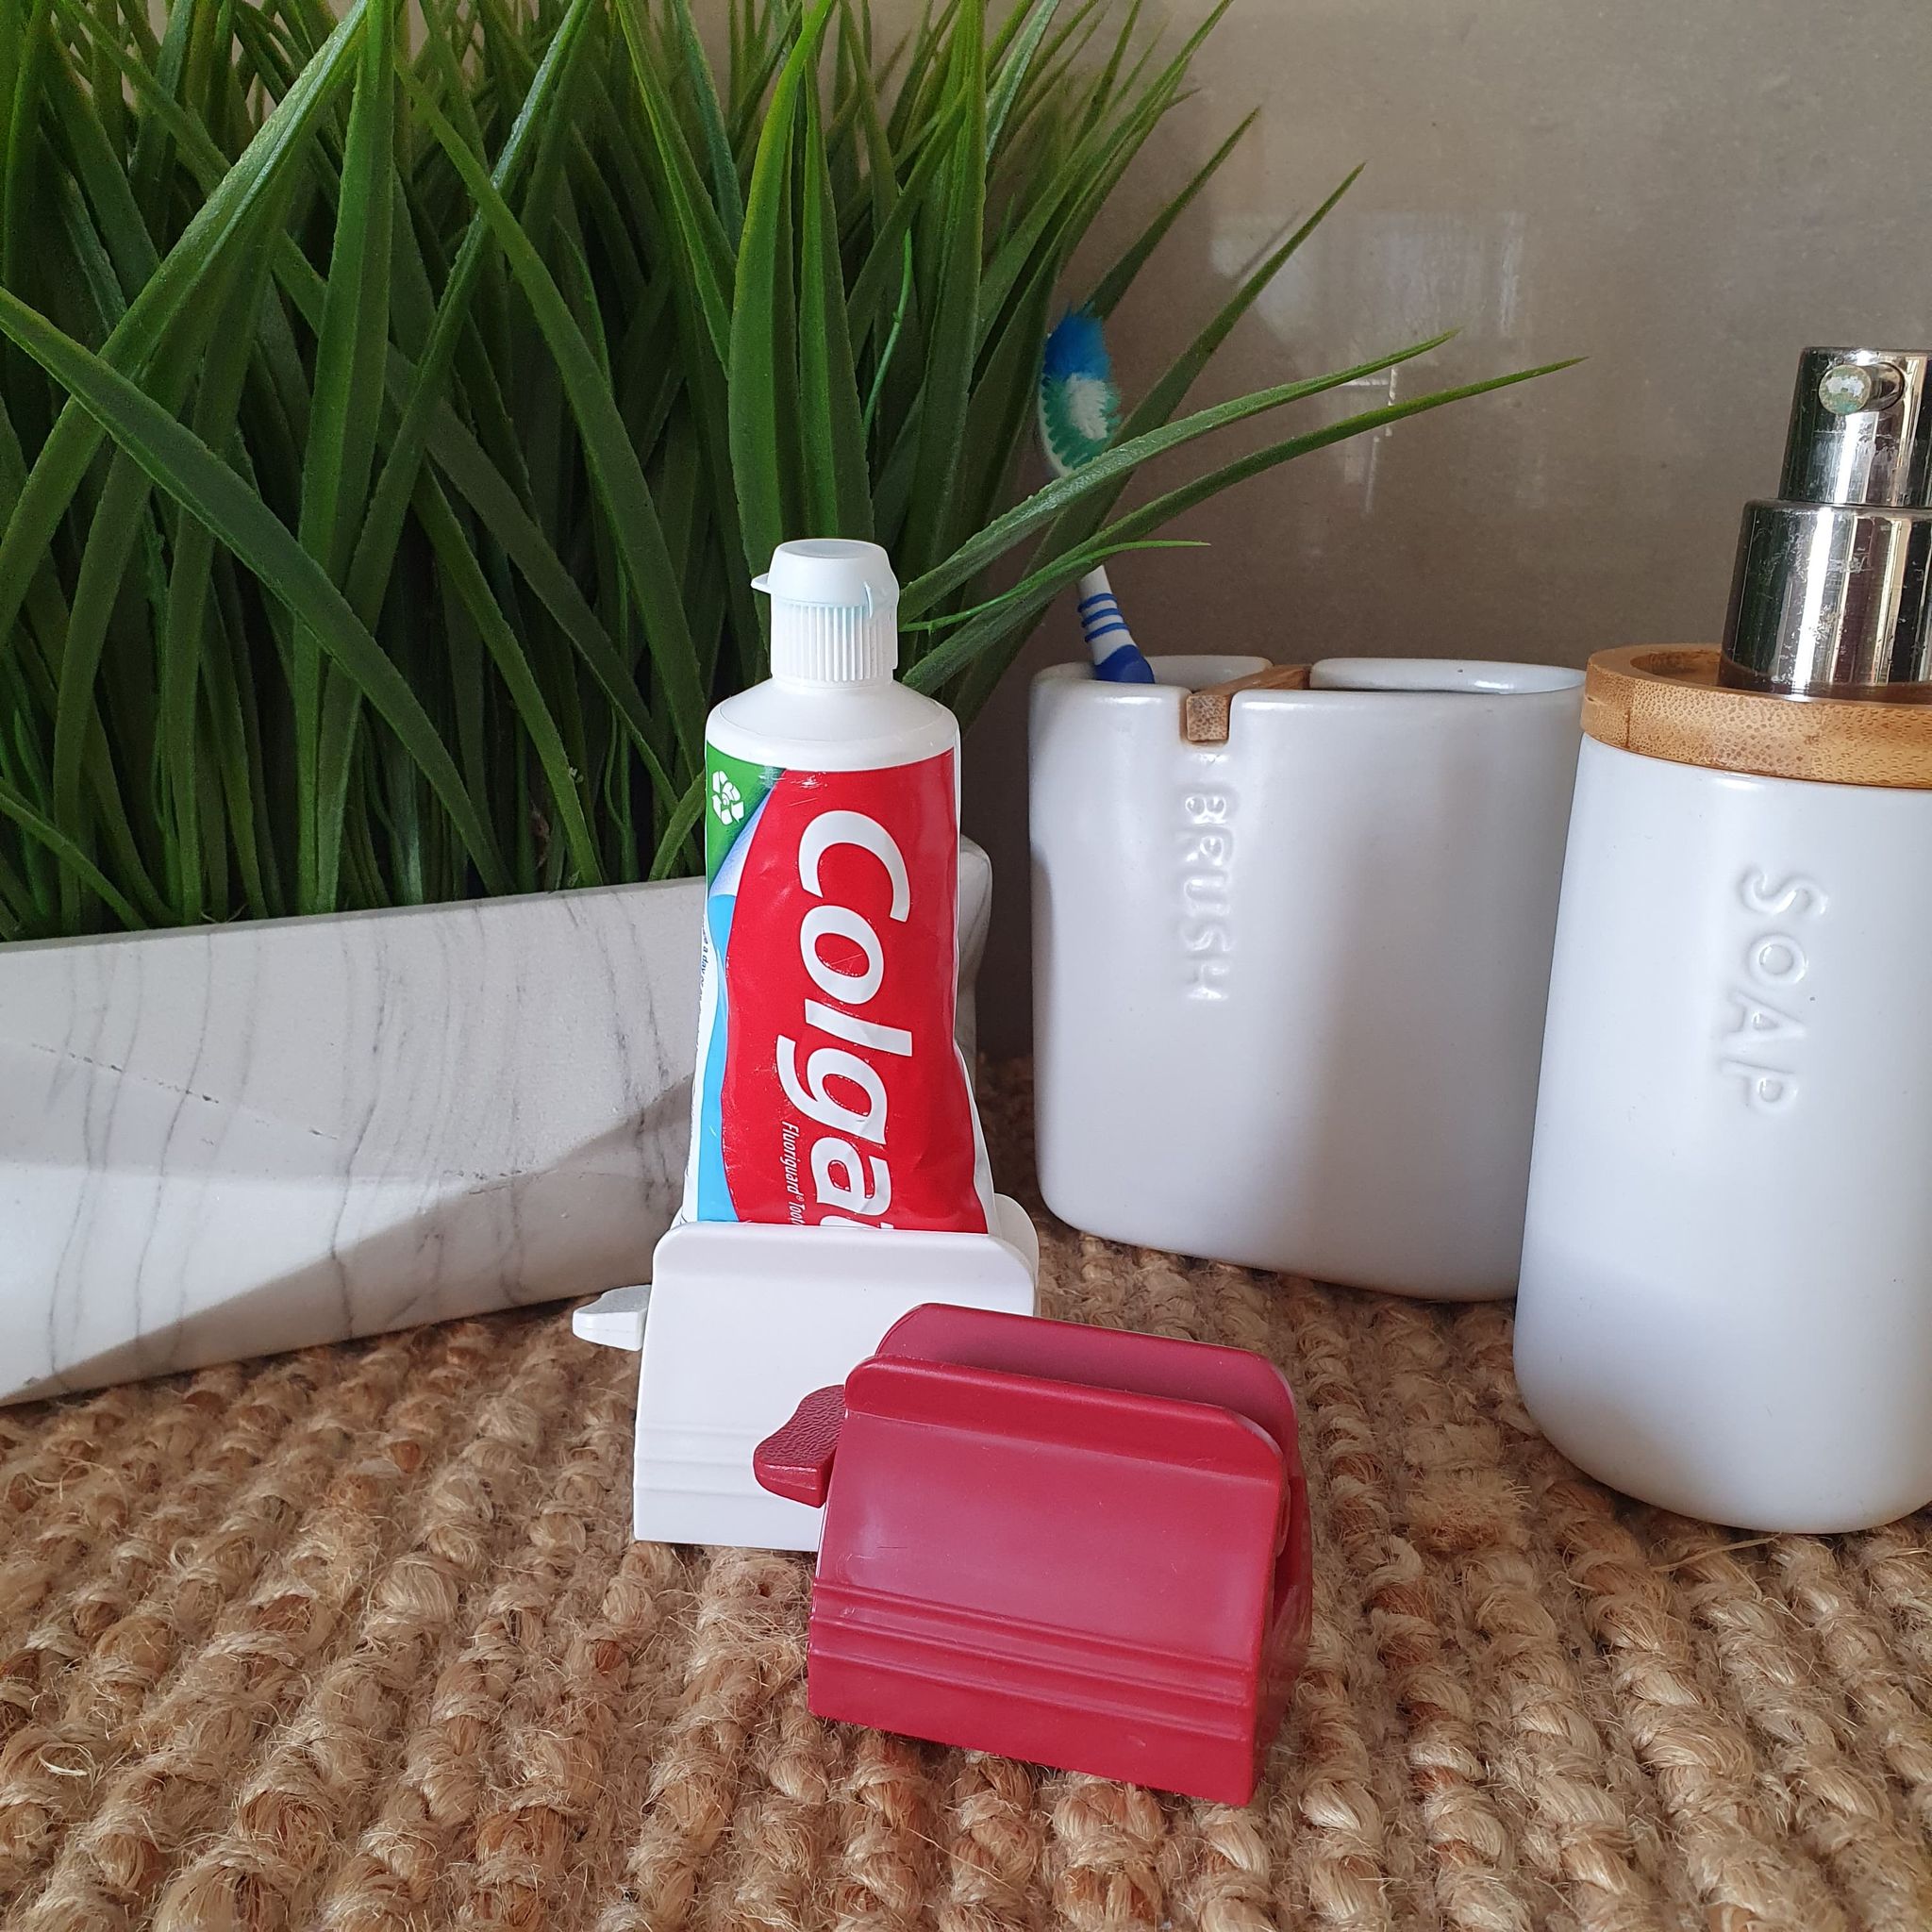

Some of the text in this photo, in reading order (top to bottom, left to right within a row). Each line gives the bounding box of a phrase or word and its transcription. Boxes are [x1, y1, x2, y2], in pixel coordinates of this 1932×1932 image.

[775, 809, 913, 1230] Colga
[1184, 791, 1233, 1002] BRUSH
[1718, 866, 1830, 1114] SOAP
